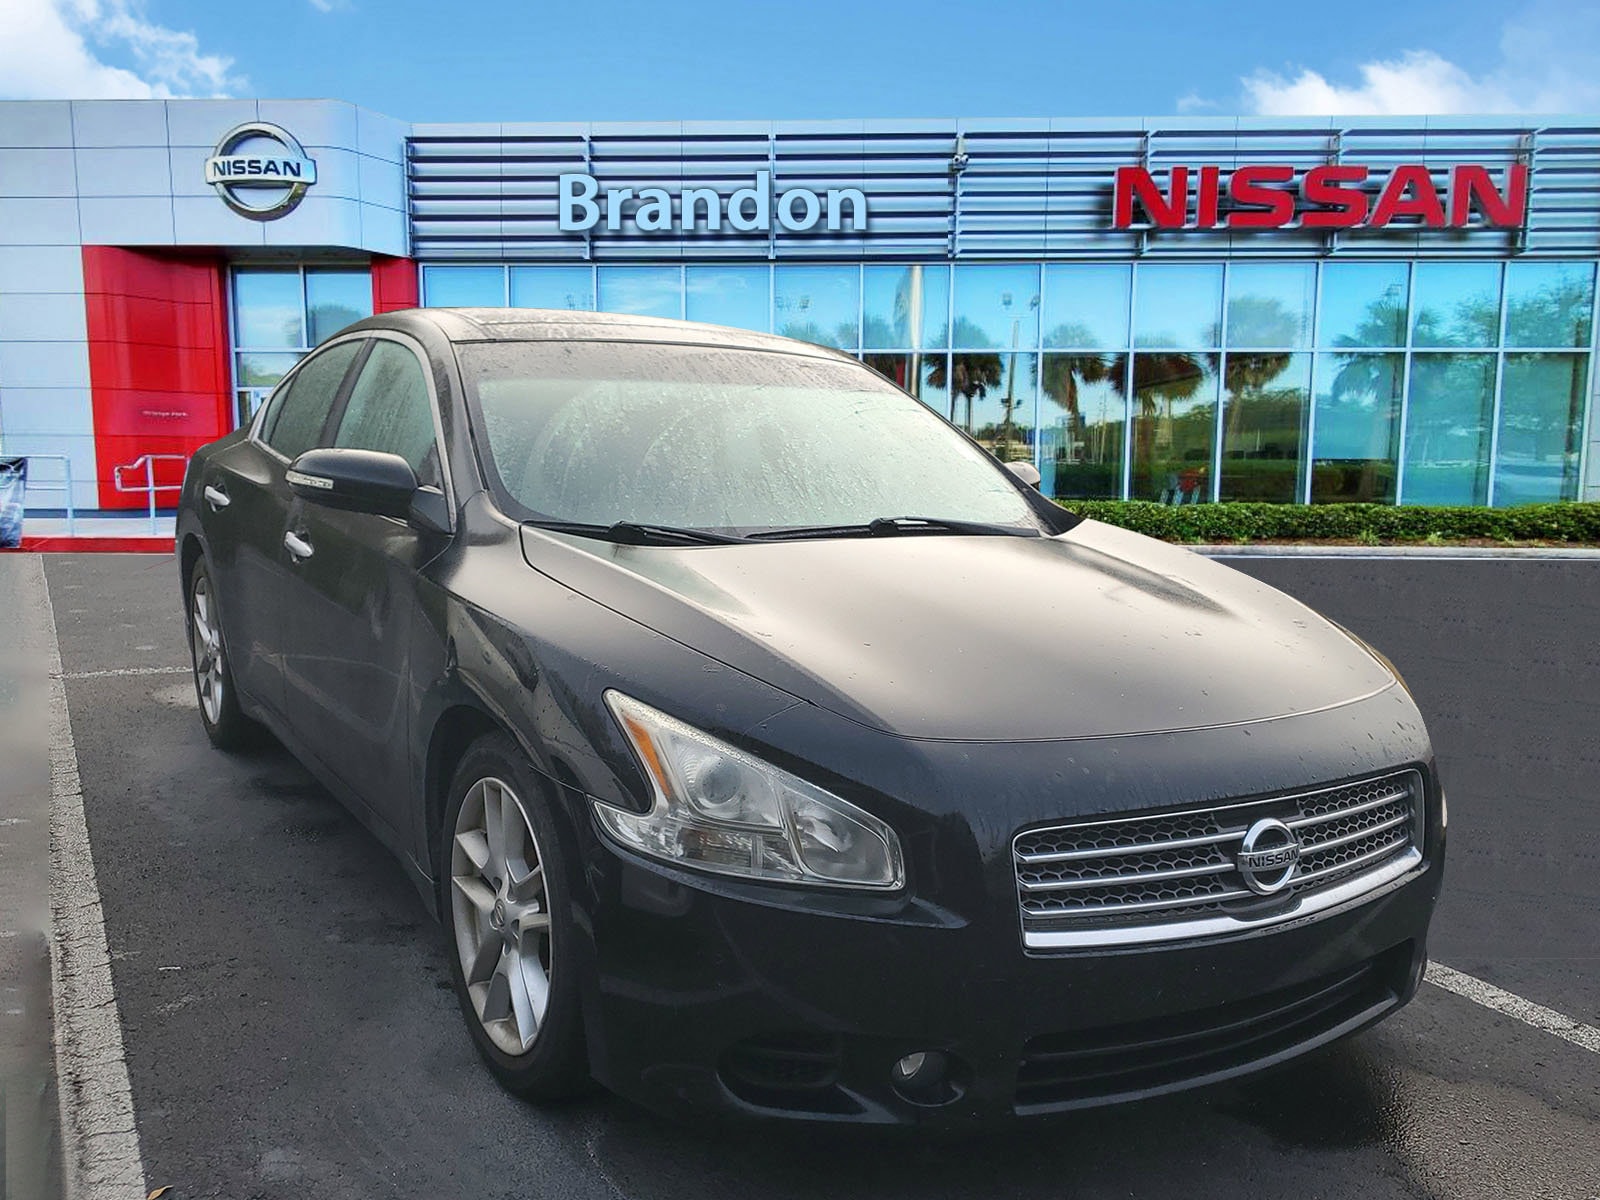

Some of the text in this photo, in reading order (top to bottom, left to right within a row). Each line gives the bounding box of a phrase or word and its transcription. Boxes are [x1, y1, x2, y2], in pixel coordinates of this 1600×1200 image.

[213, 160, 301, 177] NISSAN
[559, 170, 867, 231] Brandon
[1113, 165, 1528, 228] NISSAN
[1248, 849, 1299, 868] NISSAN
